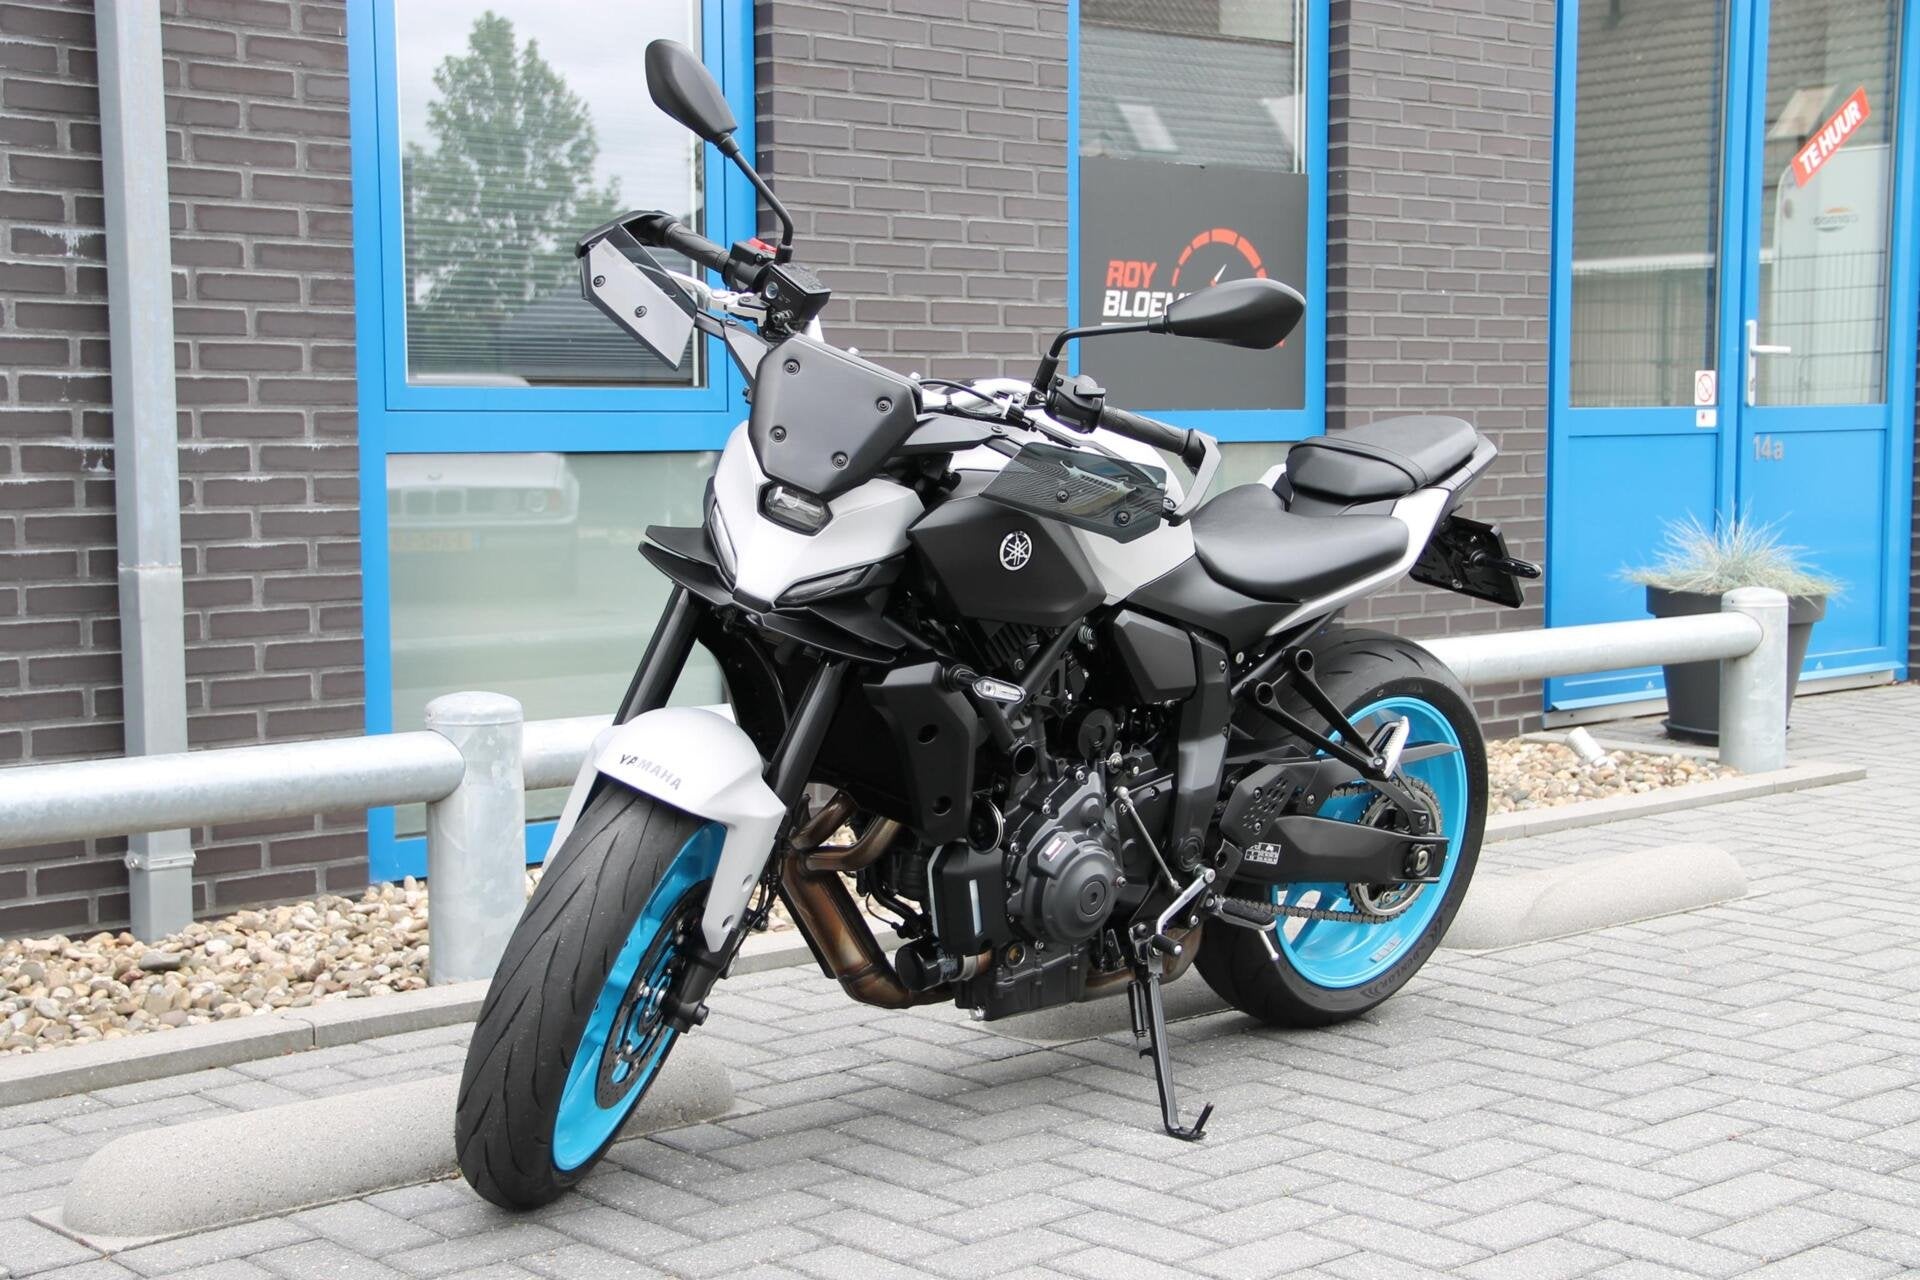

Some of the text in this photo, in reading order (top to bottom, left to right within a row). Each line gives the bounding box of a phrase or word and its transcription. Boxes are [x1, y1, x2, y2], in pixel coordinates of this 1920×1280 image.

[1800, 101, 1861, 174] TE HUUR
[1106, 260, 1157, 288] ROY
[1753, 435, 1784, 461] 14a
[620, 753, 682, 790] YAMAHA
